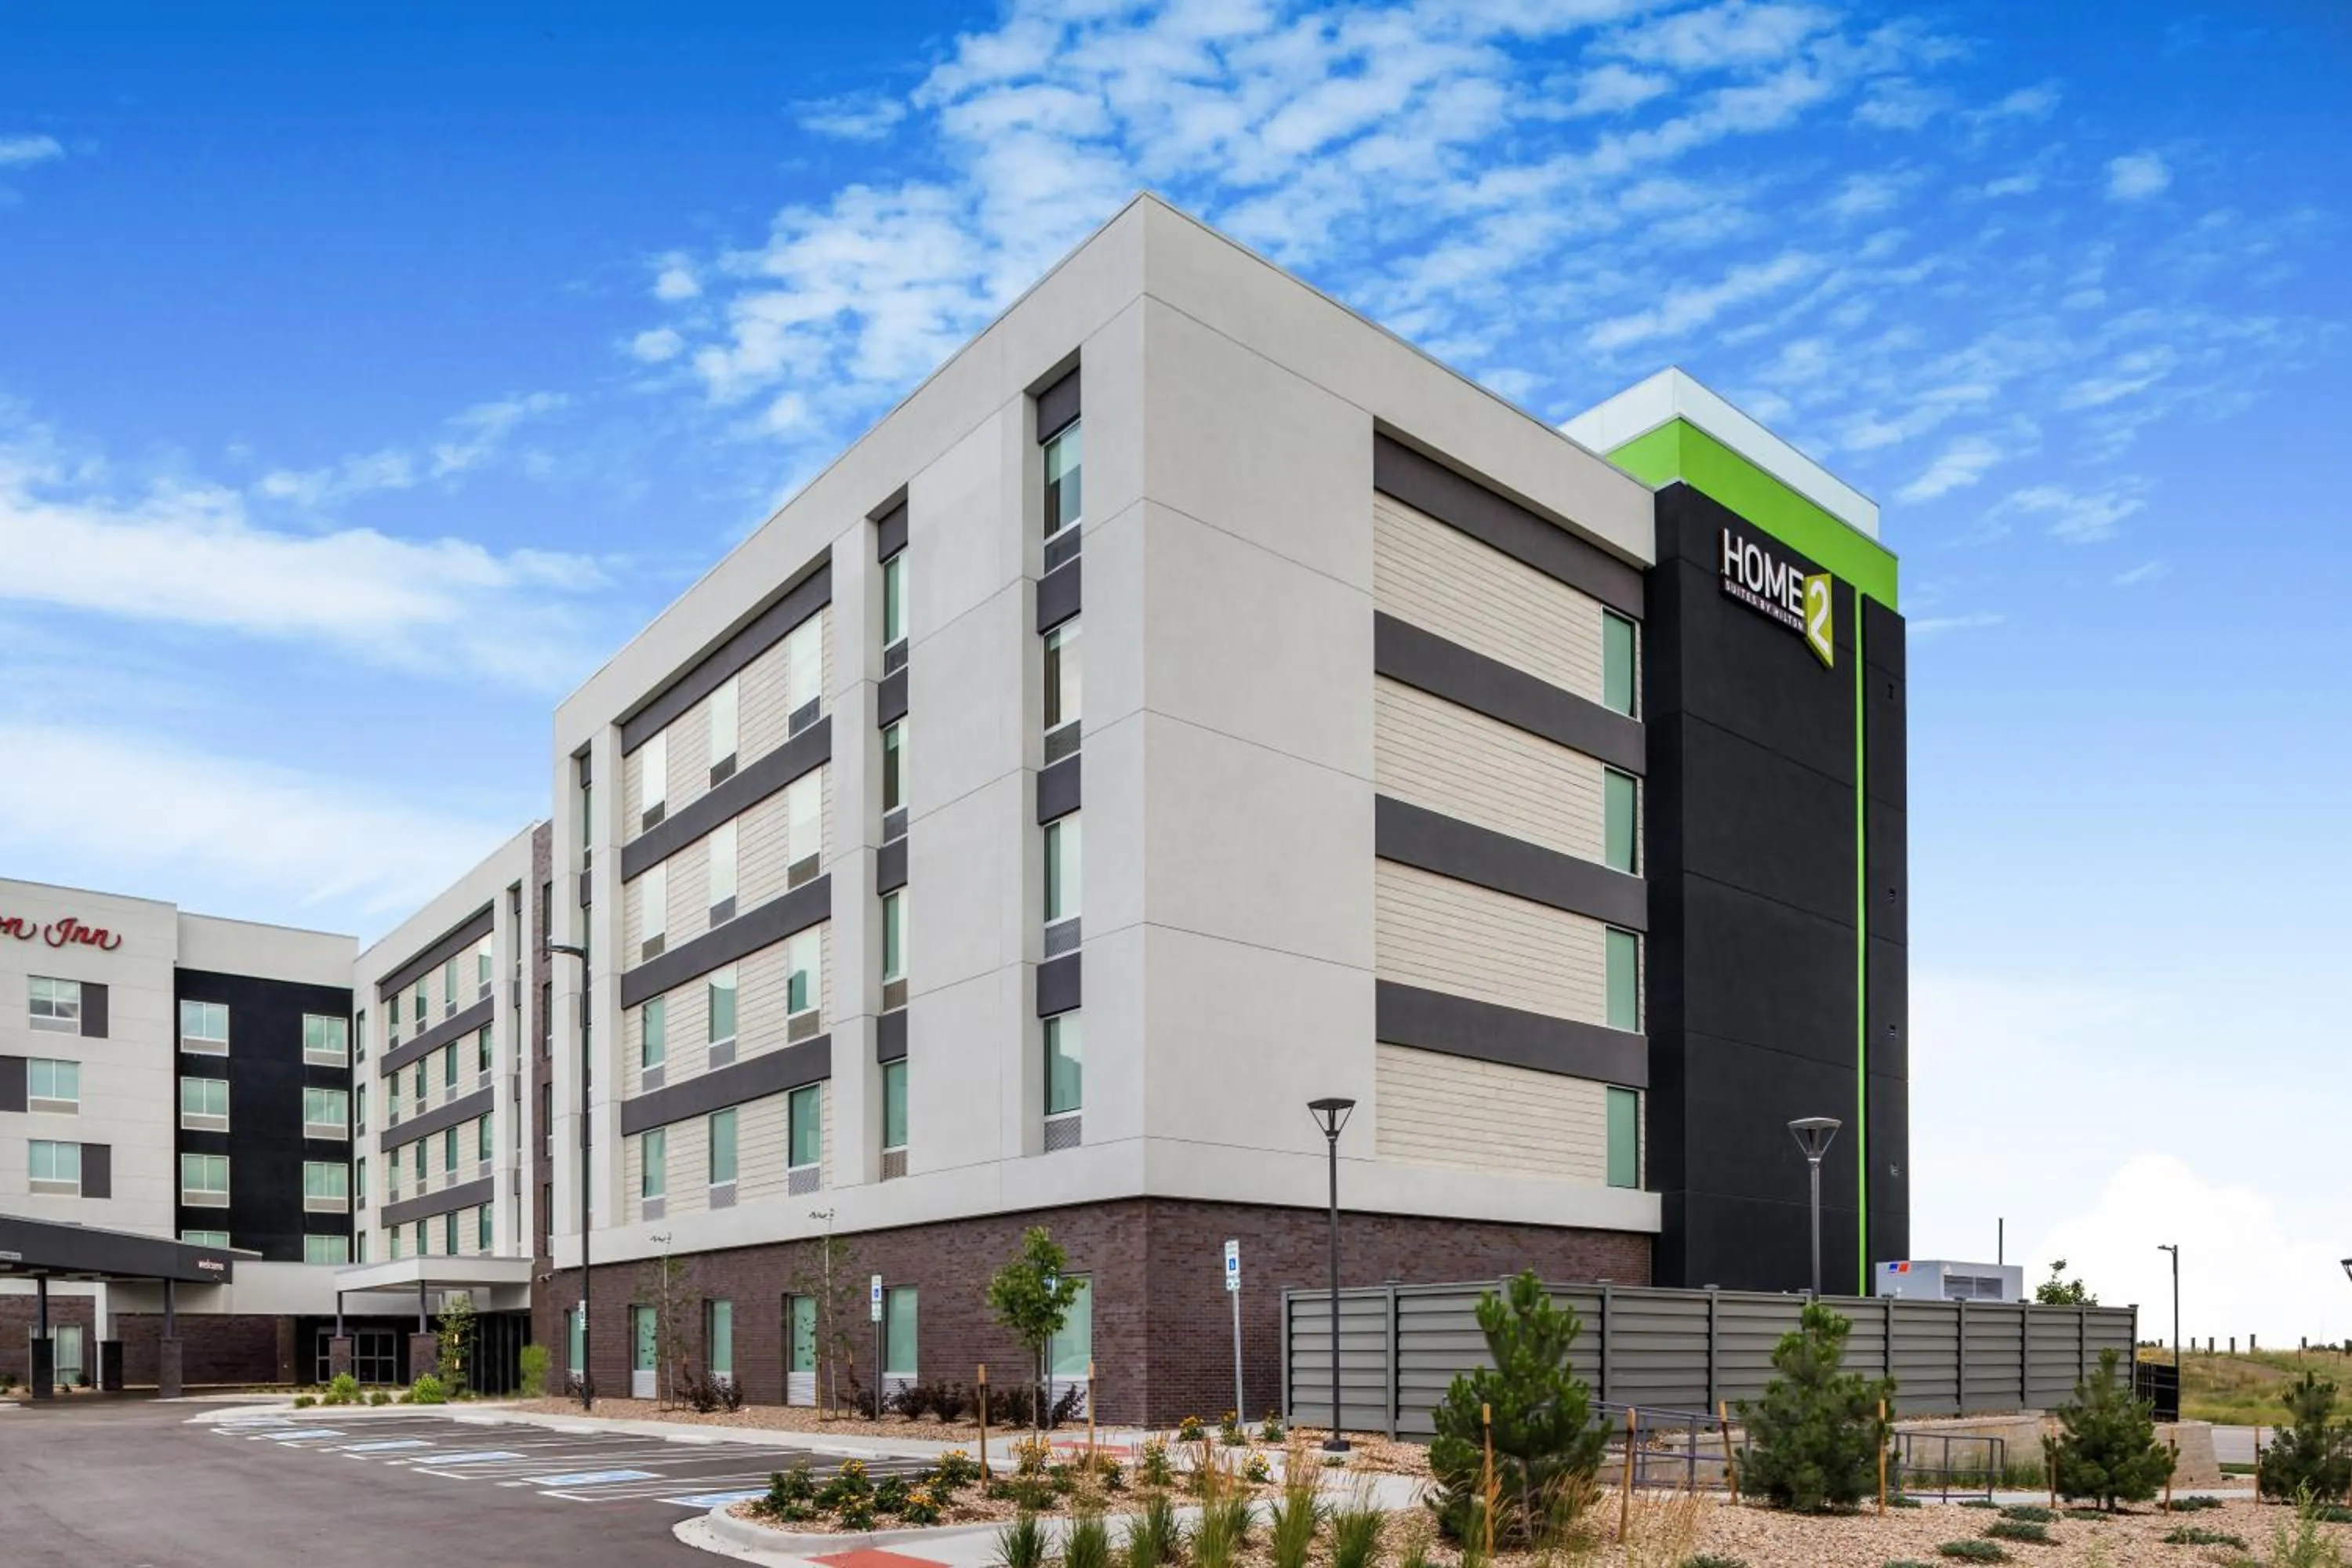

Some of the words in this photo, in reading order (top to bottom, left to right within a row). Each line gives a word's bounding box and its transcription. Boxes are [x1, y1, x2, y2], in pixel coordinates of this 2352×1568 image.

[1724, 528, 1805, 617] HOME
[1726, 580, 1757, 605] SUITES
[1759, 598, 1771, 612] BY
[1773, 608, 1804, 630] HILTON
[0, 916, 37, 940] n
[45, 918, 122, 950] Inn
